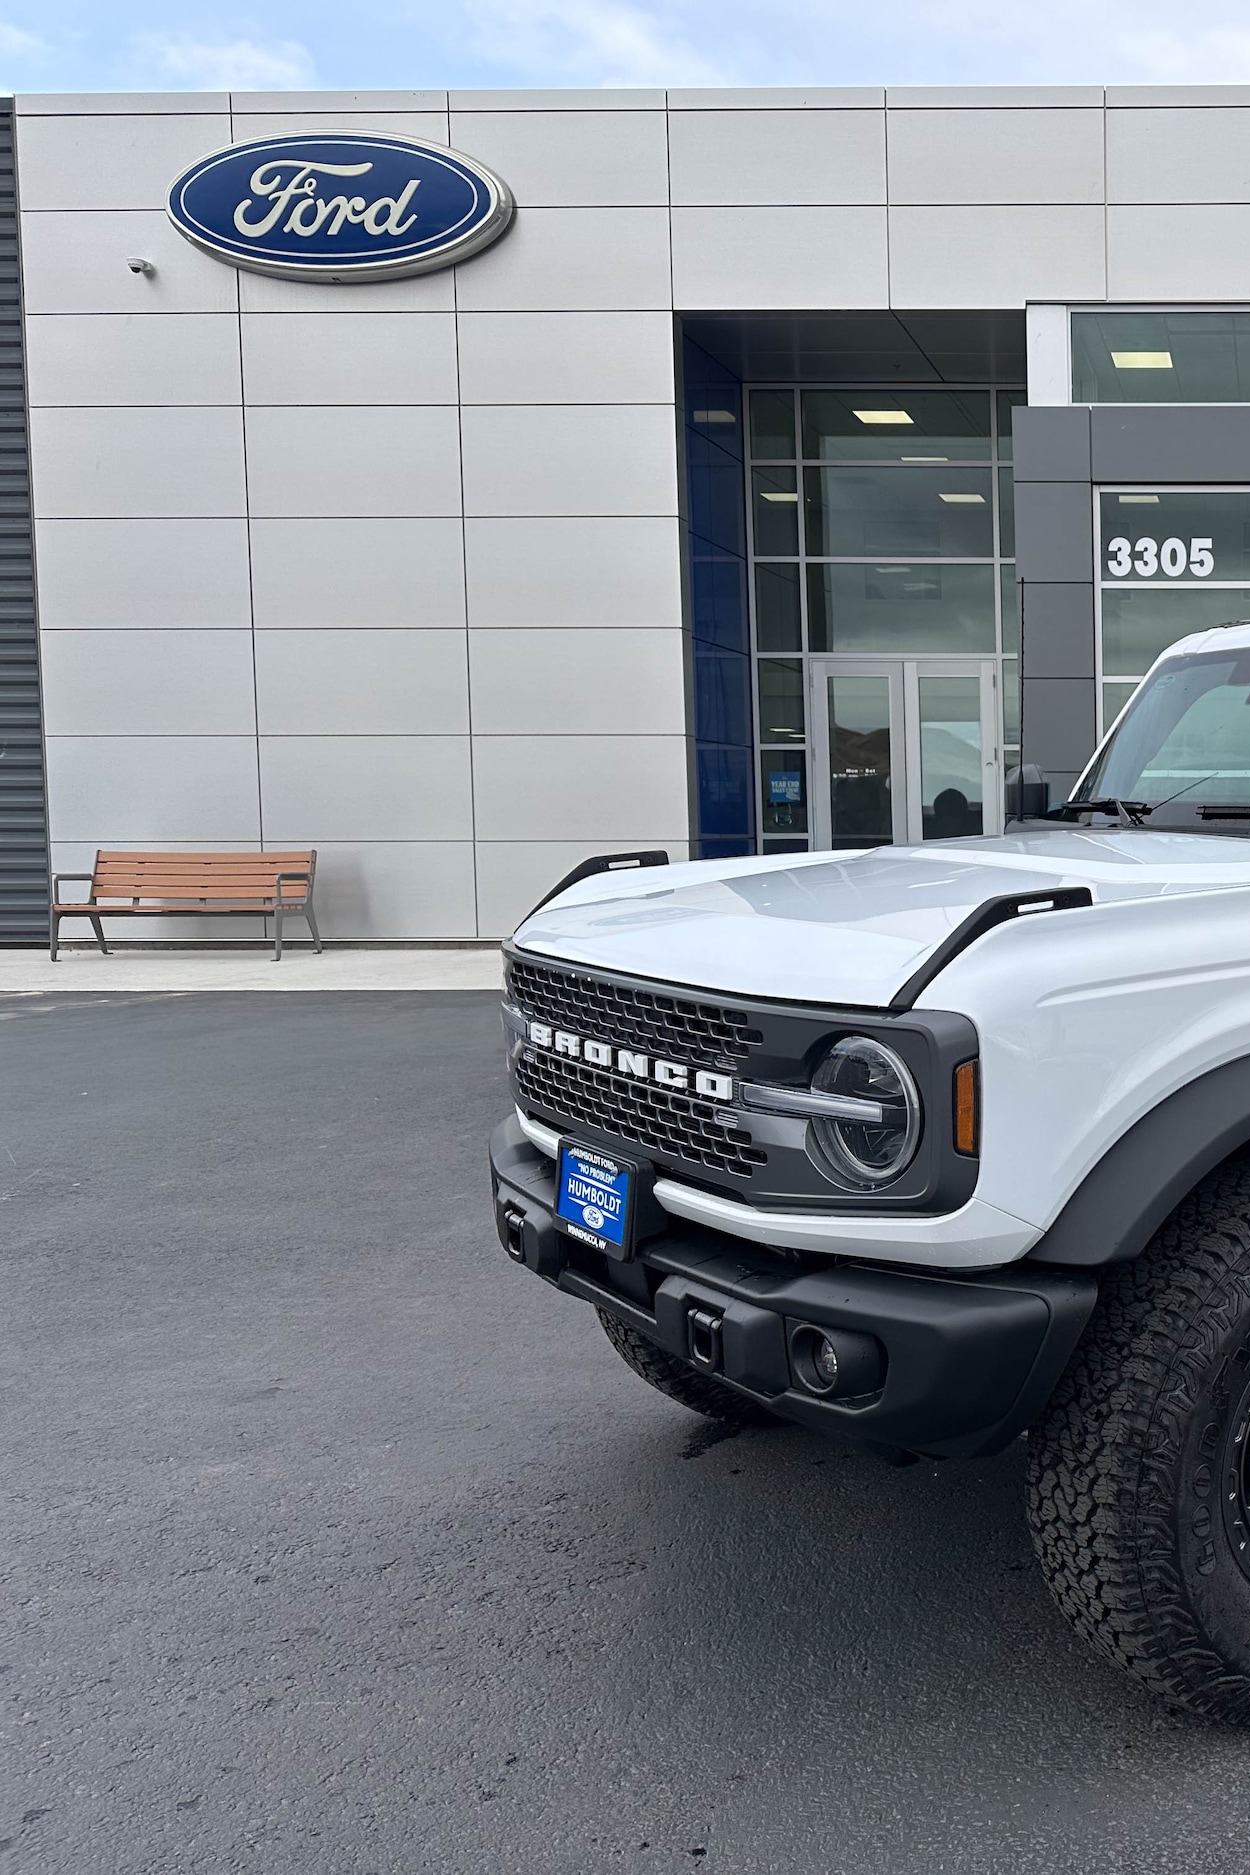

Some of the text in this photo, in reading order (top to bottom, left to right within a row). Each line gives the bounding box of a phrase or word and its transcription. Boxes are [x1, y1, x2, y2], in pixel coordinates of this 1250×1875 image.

[233, 159, 422, 238] Ford
[1107, 536, 1215, 577] 3305
[770, 780, 787, 788] YEAR
[530, 1021, 733, 1100] BRONCO
[573, 1147, 615, 1171] HUMBOLDT FORD
[577, 1163, 616, 1185] "NO PROBLEM"
[568, 1178, 621, 1214] HUMBOLDT
[587, 1209, 600, 1224] Ford
